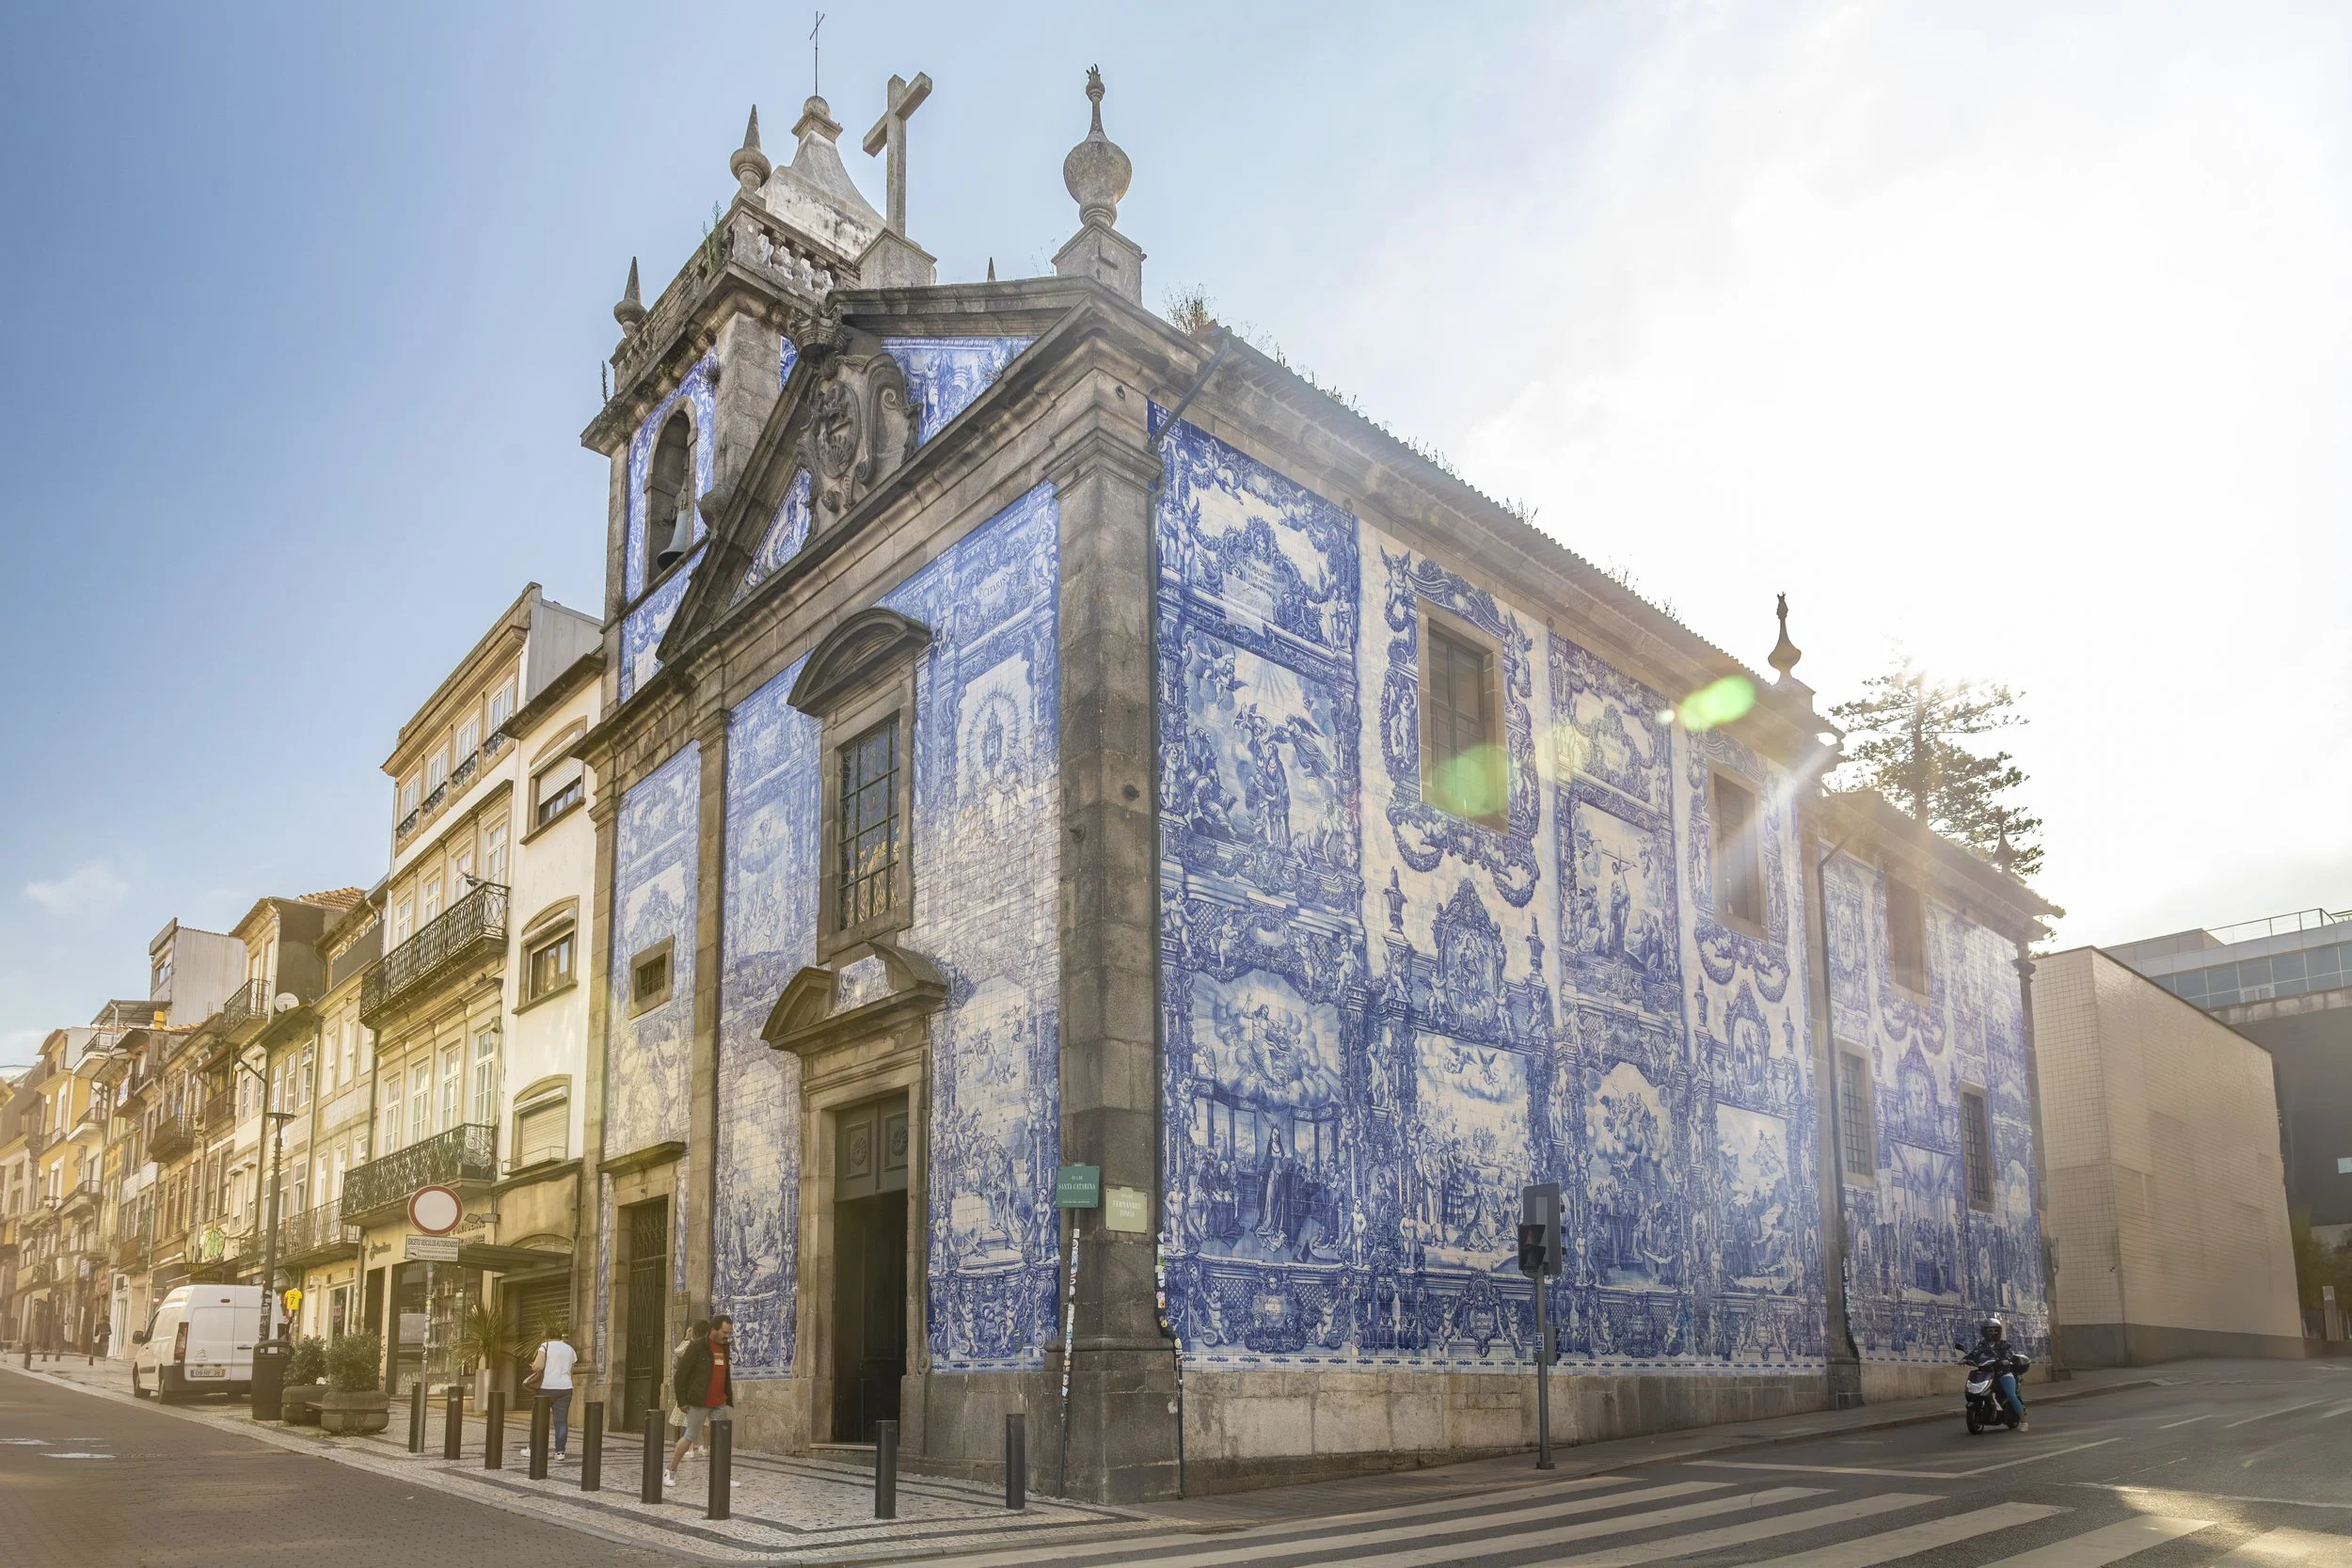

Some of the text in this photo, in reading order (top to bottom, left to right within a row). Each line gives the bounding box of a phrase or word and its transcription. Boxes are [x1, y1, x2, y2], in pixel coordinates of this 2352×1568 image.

[1113, 1199, 1142, 1210] FERNANDES
[437, 1240, 458, 1248] AUTORIZADOS
[290, 1296, 295, 1305] 7
